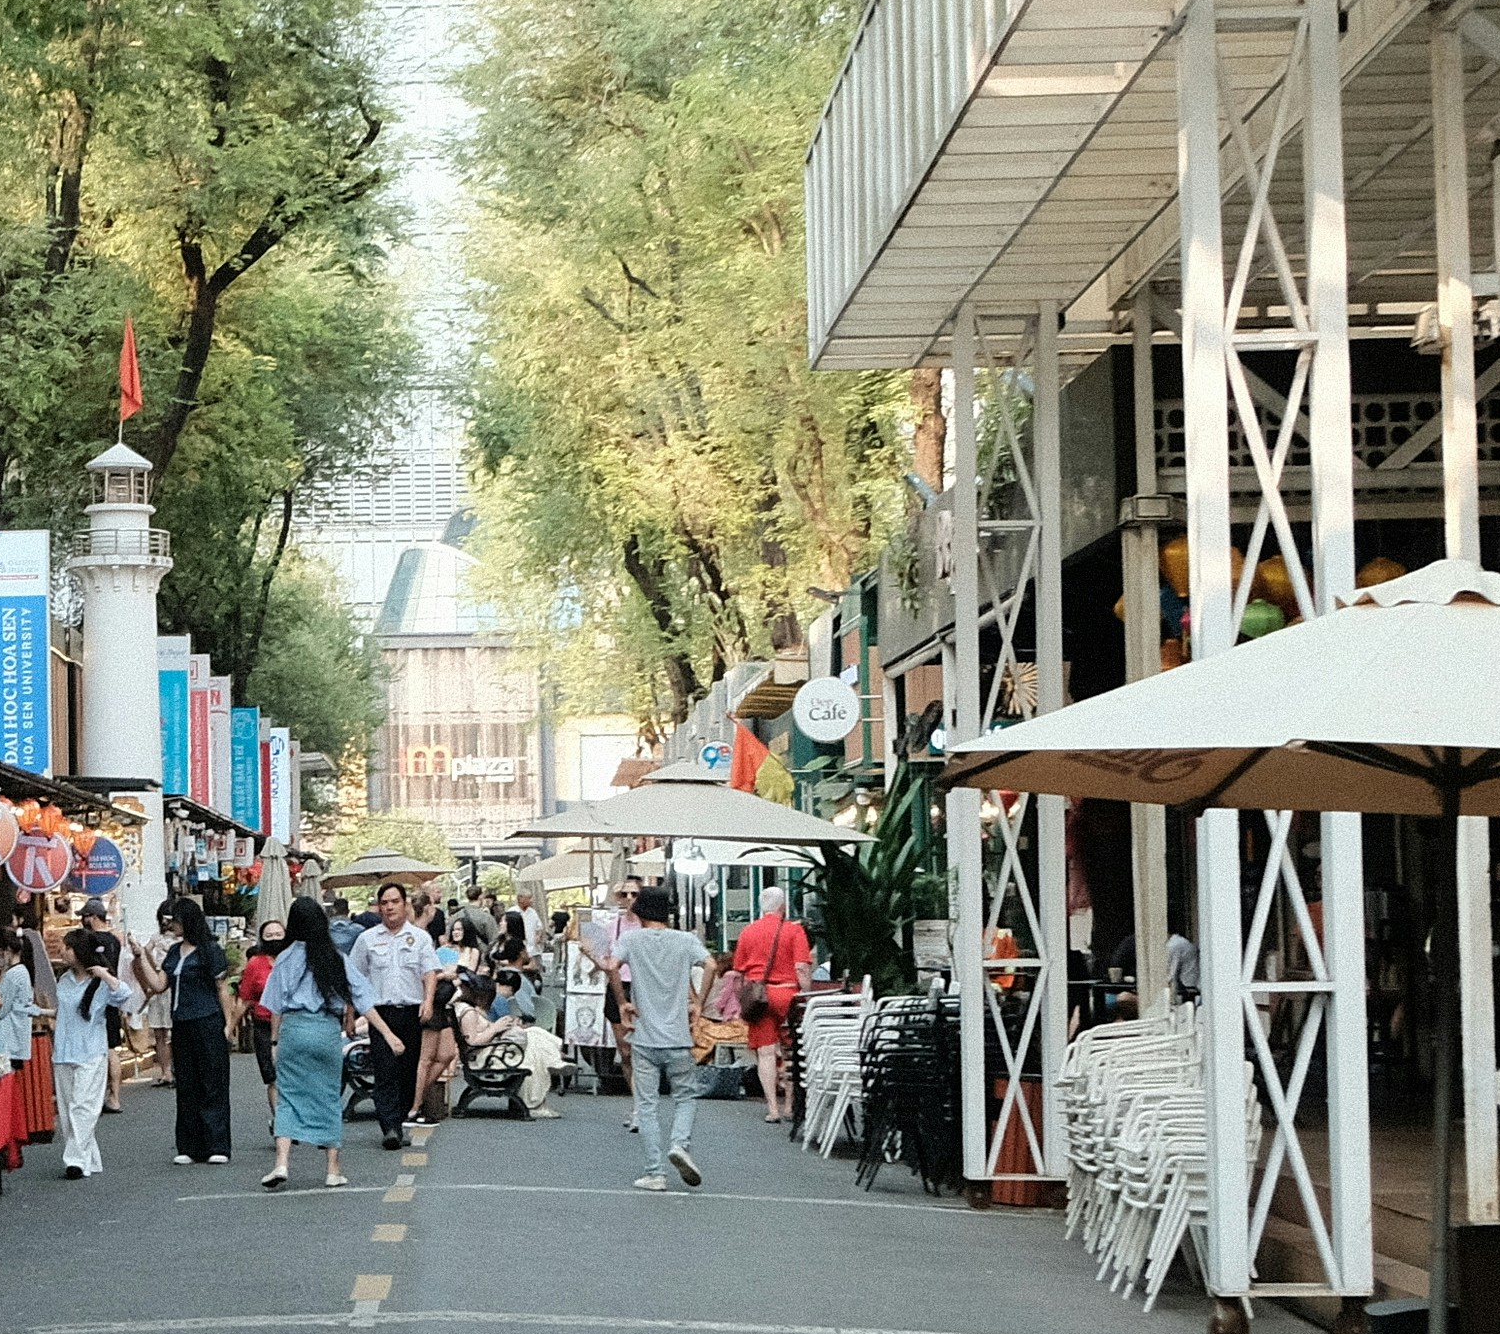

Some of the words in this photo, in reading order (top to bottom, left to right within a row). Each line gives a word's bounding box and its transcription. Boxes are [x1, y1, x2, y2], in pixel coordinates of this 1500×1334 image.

[1, 607, 17, 641] SEN
[2, 644, 17, 684] HOA
[21, 607, 34, 694] UNIVERSITY
[22, 701, 34, 729] SEN
[22, 735, 34, 765] HOA
[451, 754, 515, 782] plaza
